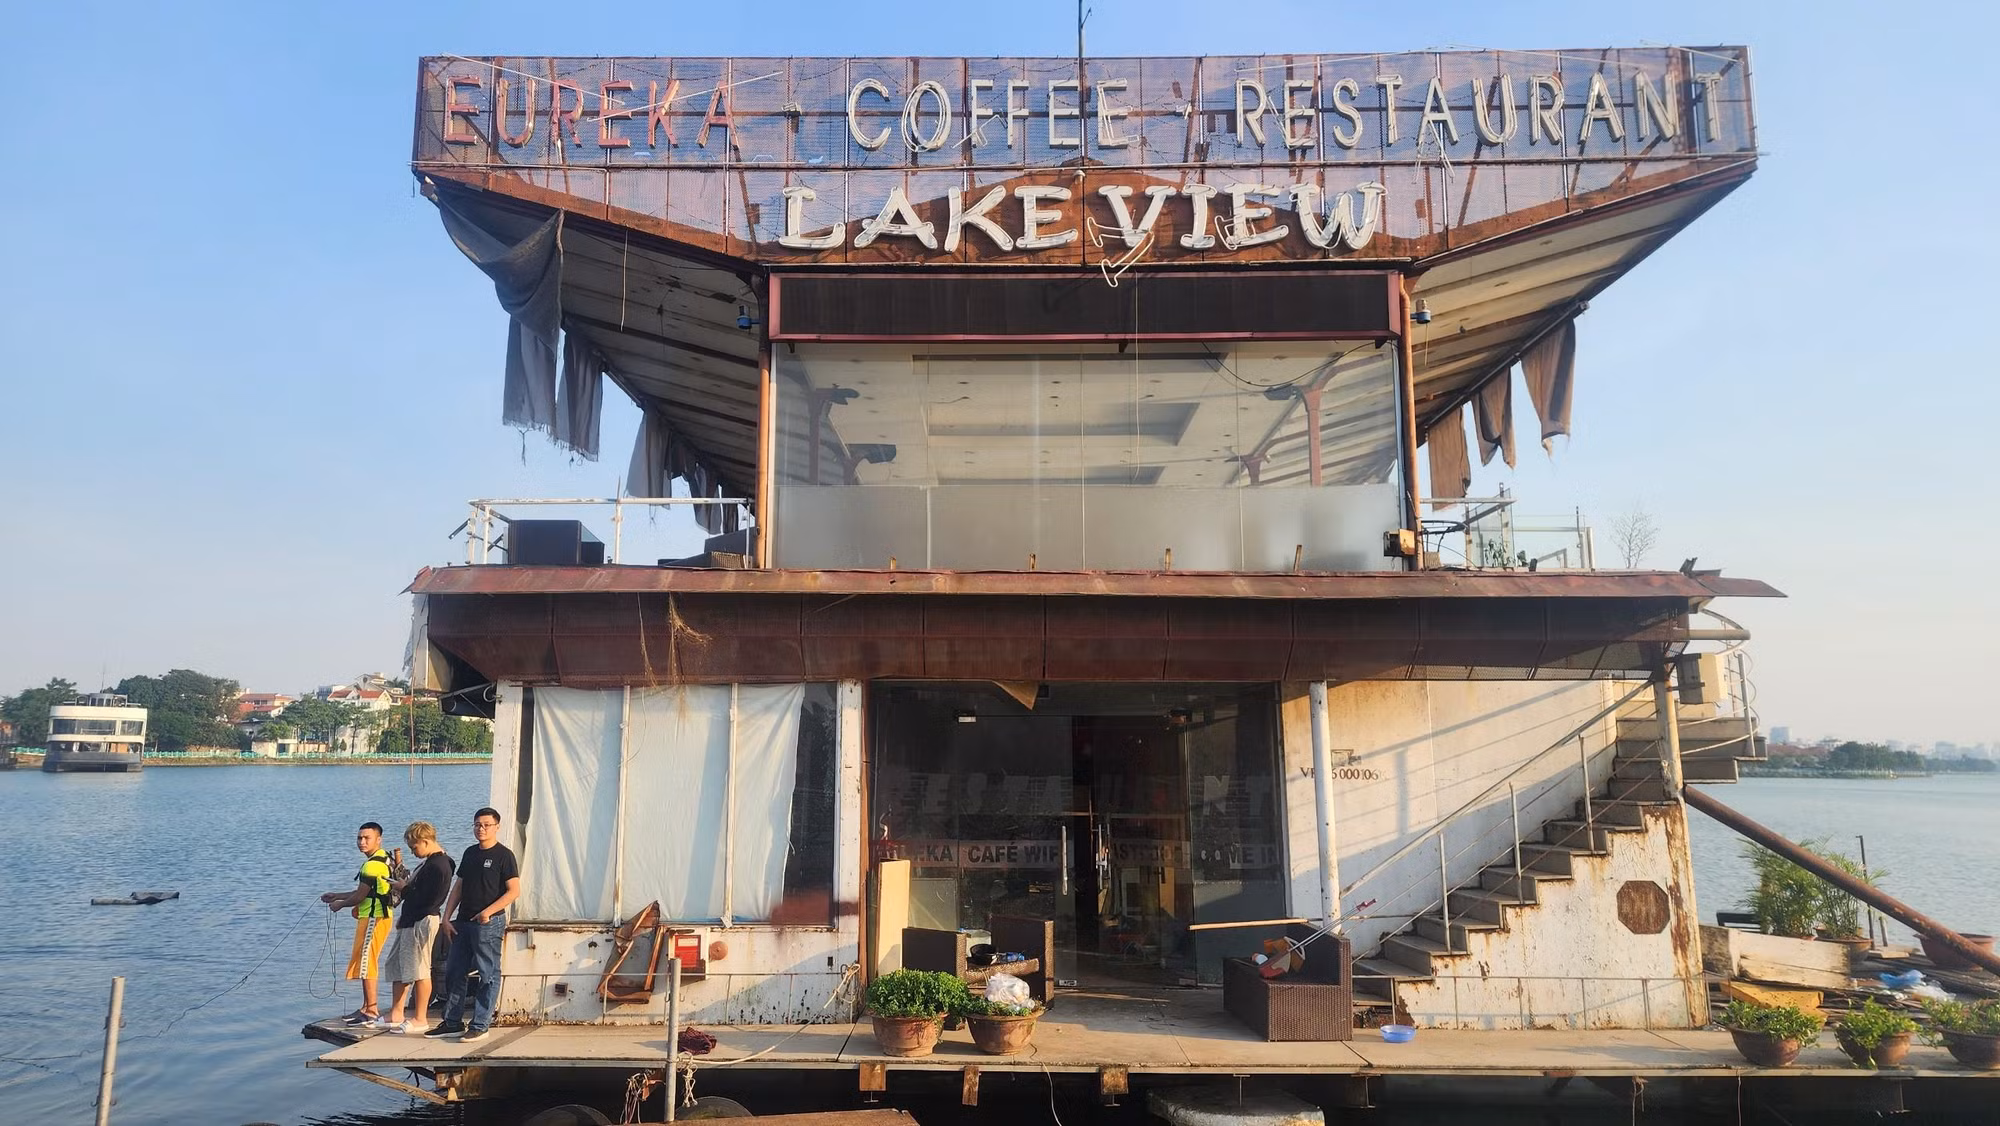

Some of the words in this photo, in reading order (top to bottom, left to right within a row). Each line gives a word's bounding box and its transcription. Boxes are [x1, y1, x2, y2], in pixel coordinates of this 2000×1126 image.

[445, 75, 741, 148] EUREKA
[849, 78, 1128, 151] COFFEE
[1235, 72, 1722, 149] RESTAURANT
[967, 841, 1018, 863] CAFÉ
[1023, 845, 1065, 864] WIF
